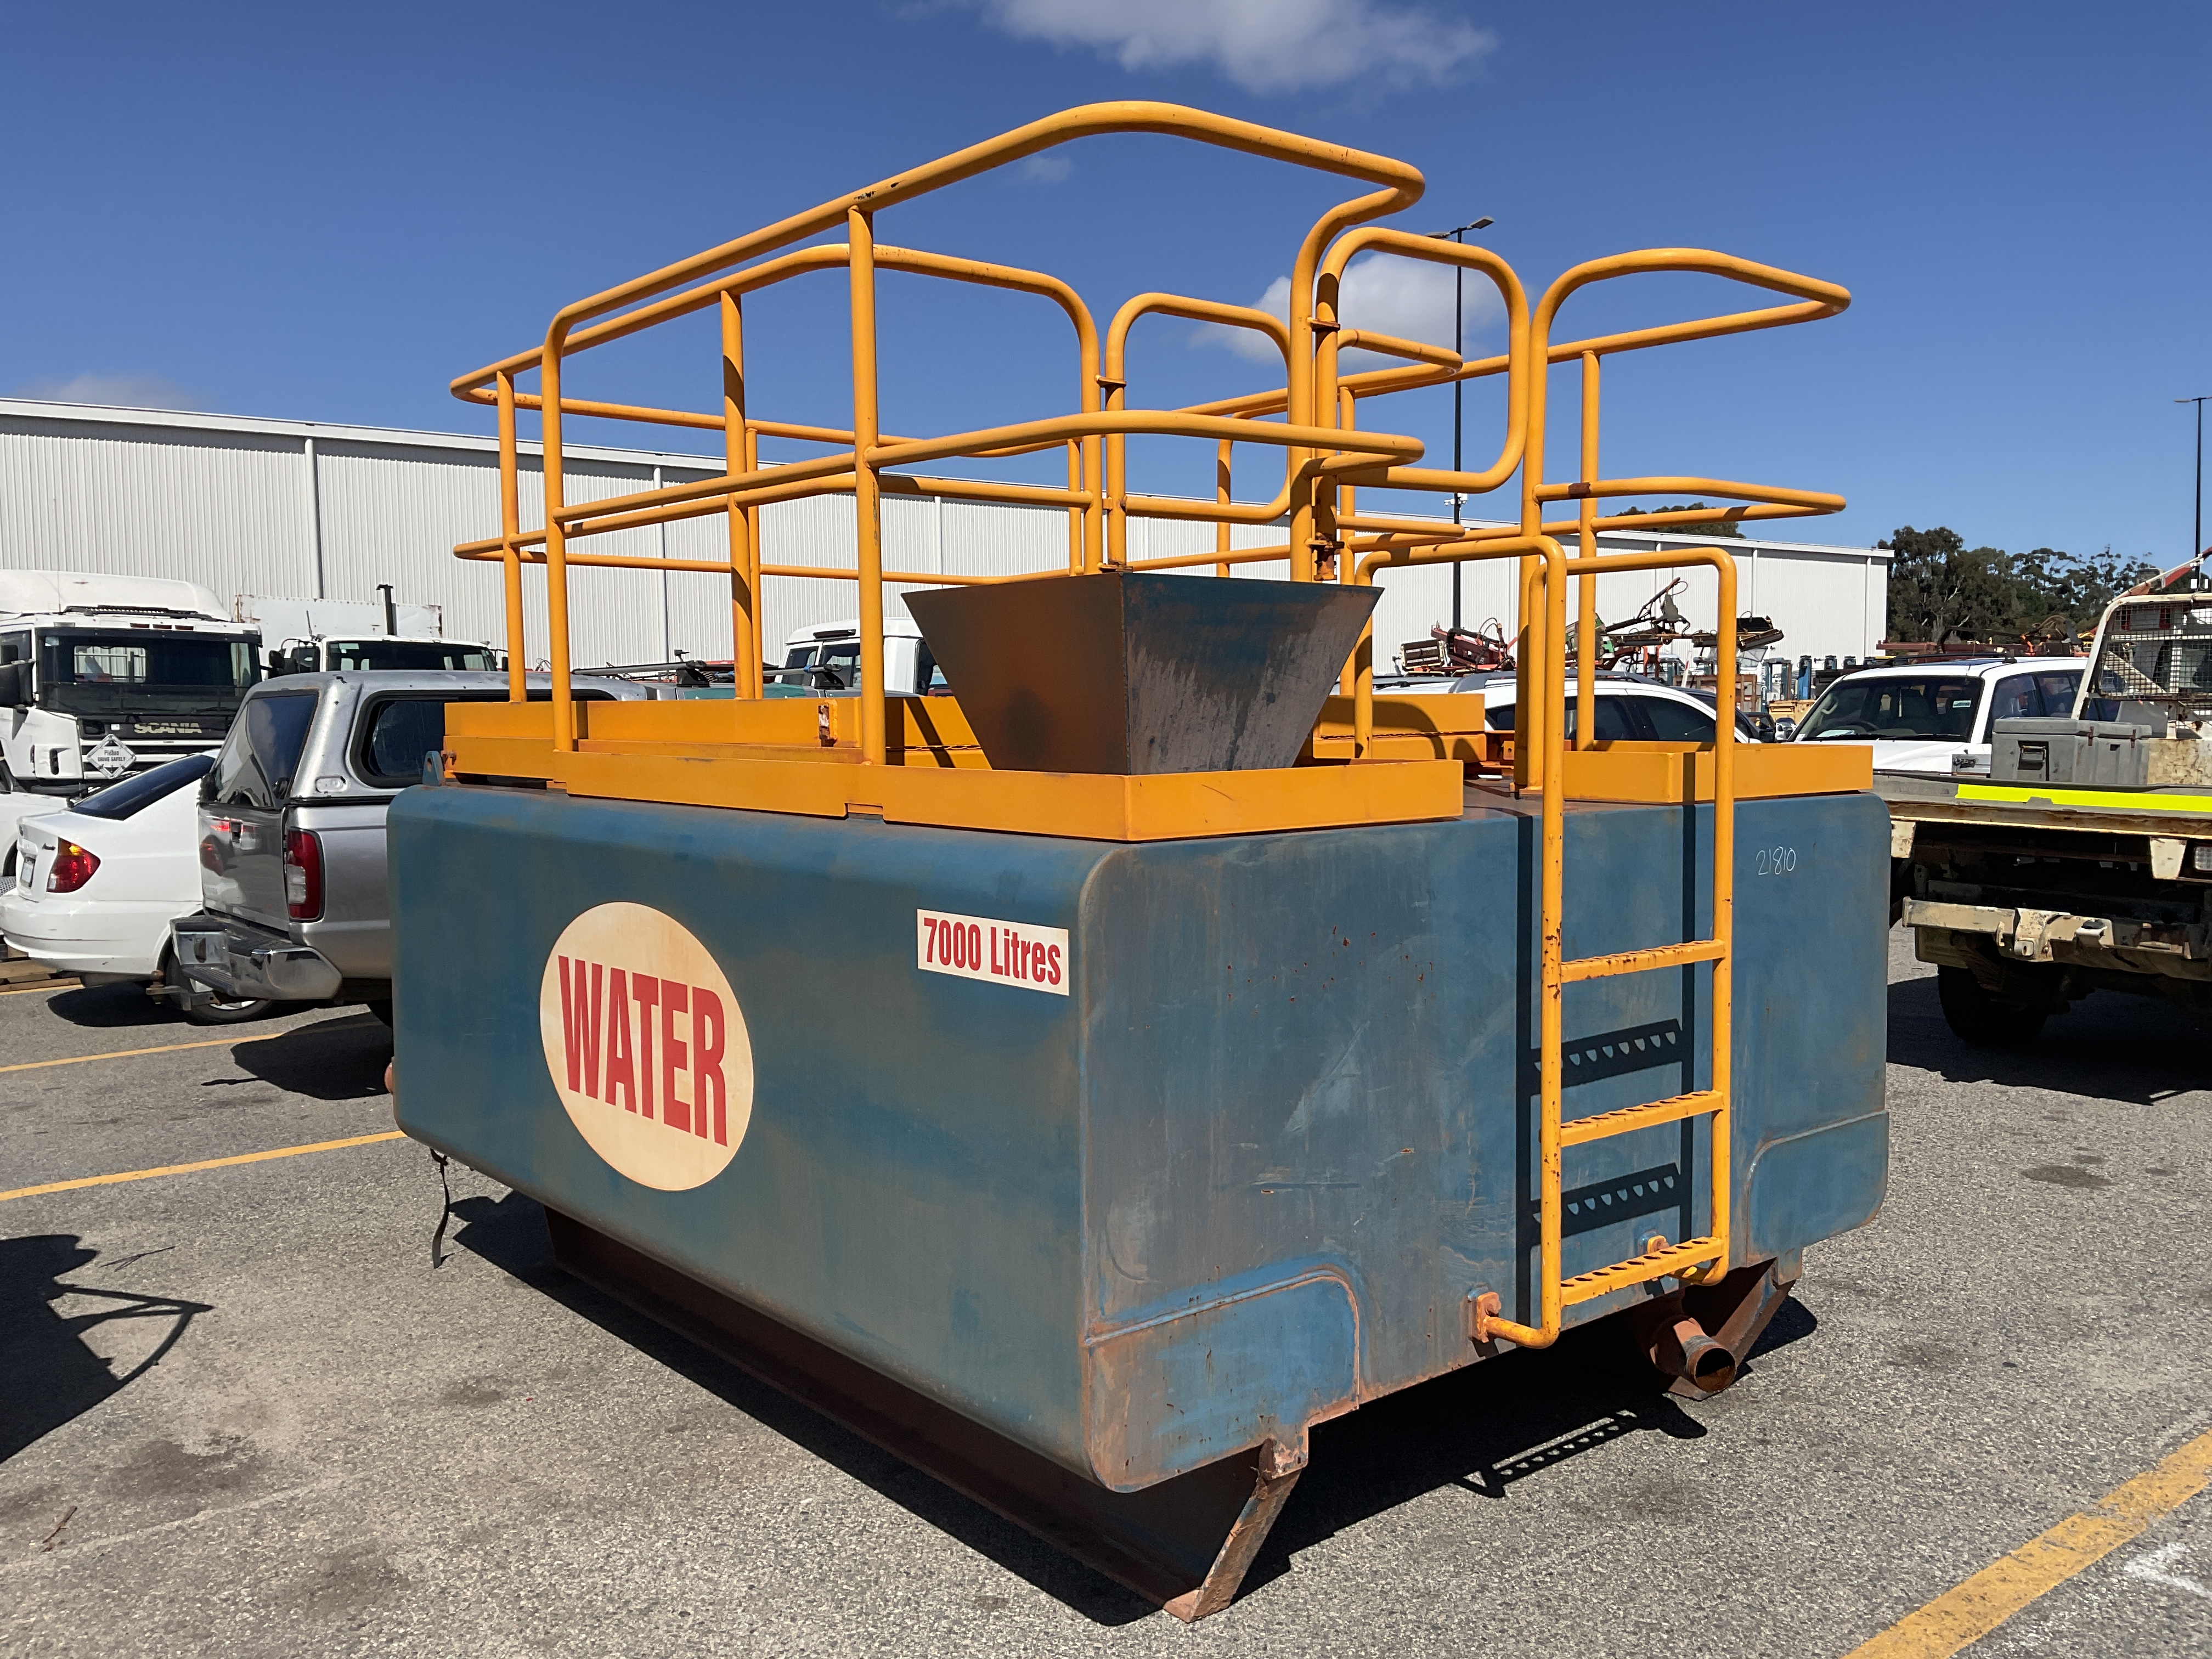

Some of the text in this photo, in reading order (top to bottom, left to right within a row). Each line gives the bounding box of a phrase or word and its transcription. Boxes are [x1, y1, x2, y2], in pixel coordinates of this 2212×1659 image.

[134, 723, 202, 733] SCANIA
[1756, 846, 1796, 876] 21810
[924, 917, 1061, 985] 7000 Litres
[558, 955, 728, 1147] WATER
